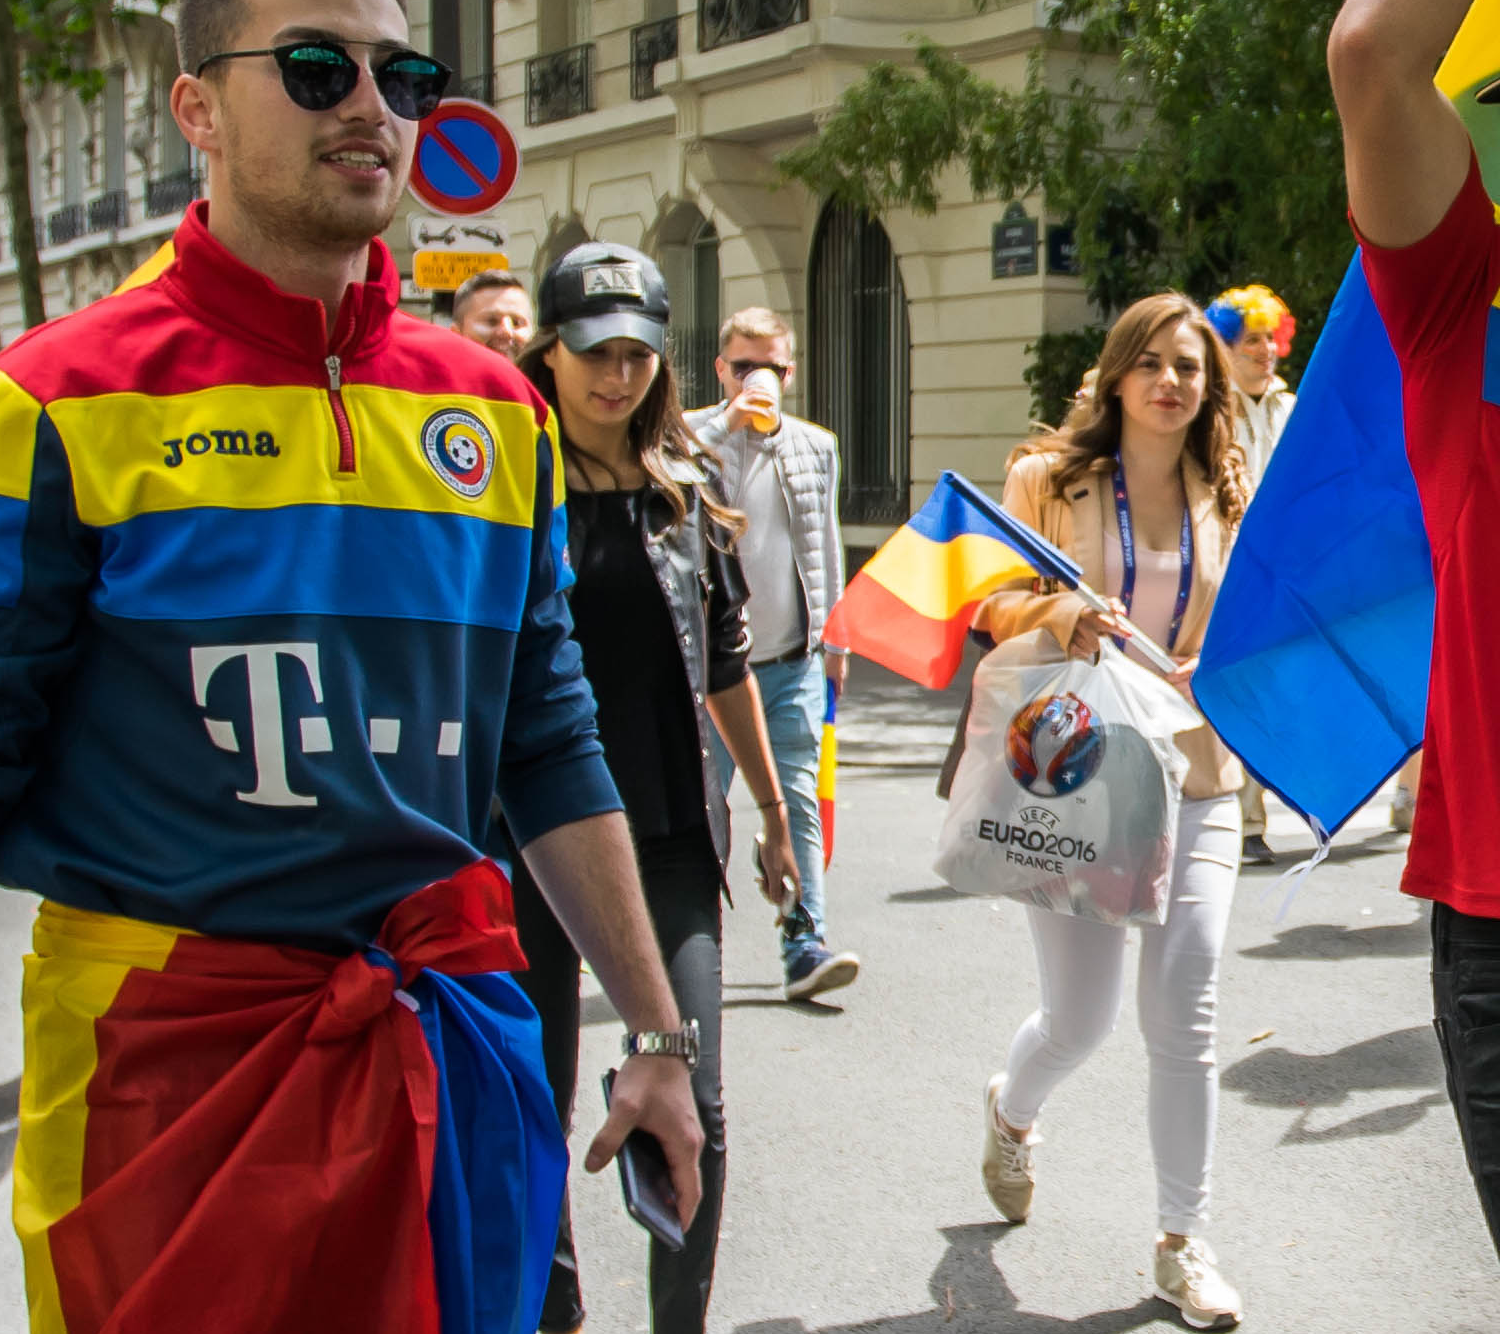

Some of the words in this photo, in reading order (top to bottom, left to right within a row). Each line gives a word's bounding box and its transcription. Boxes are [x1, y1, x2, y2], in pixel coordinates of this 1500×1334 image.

[1020, 809, 1057, 829] UEFA
[978, 819, 1097, 863] EURO2016
[1006, 850, 1065, 875] FRANCE
